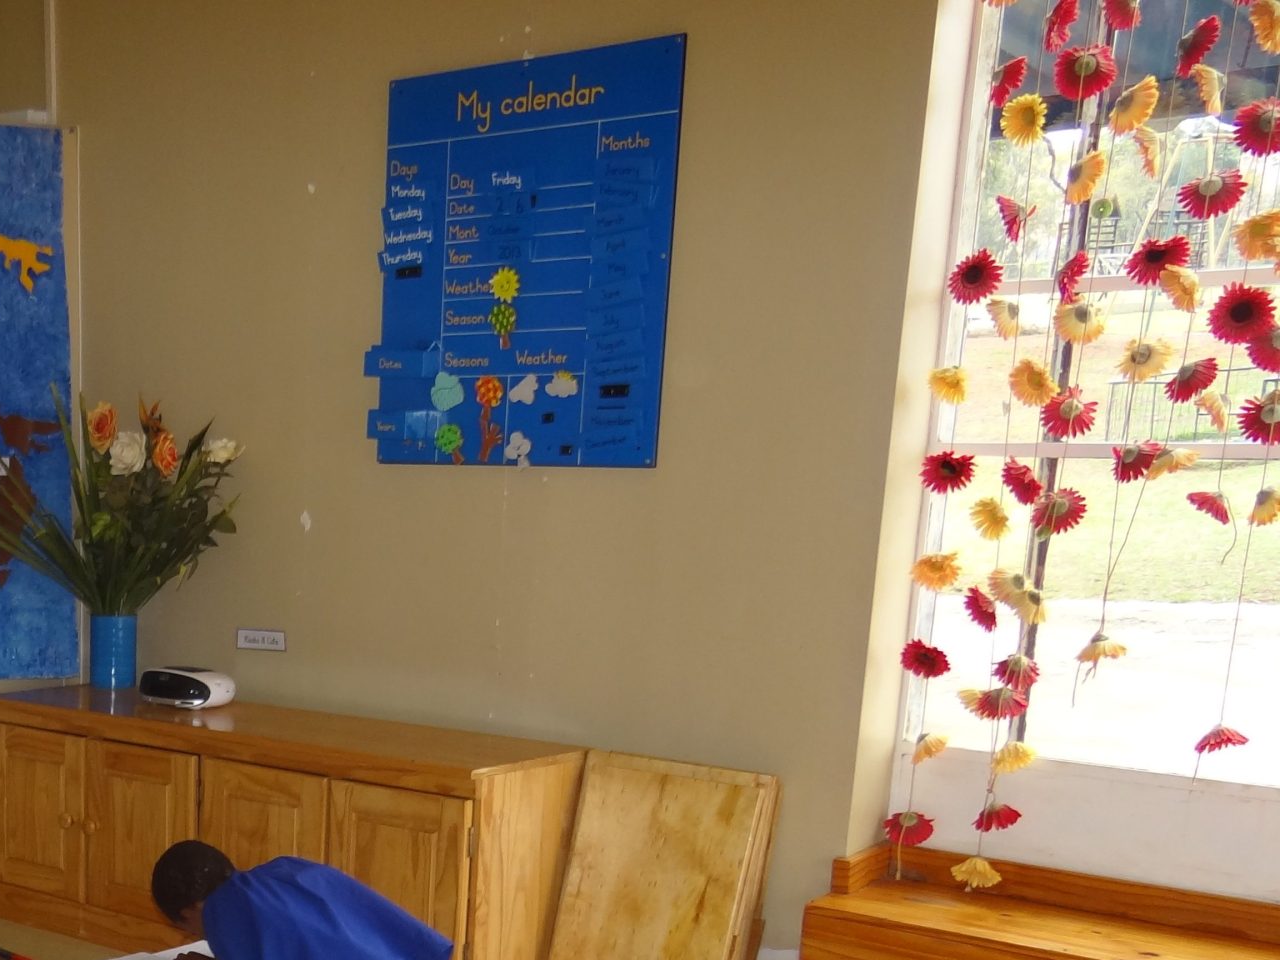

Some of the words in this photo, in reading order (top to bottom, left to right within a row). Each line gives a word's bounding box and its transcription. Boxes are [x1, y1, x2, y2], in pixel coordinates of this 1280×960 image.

[456, 89, 491, 132] My
[500, 73, 604, 115] calendar
[600, 130, 651, 152] Months
[390, 160, 419, 181] Days
[490, 170, 522, 189] Friday
[391, 184, 425, 201] Monday
[449, 174, 474, 195] Day
[389, 205, 422, 222] Tuesday
[449, 202, 475, 215] Date
[384, 225, 433, 245] Wednesday
[448, 224, 480, 240] Mont
[382, 249, 423, 265] Thursday
[448, 247, 472, 264] Year
[445, 276, 492, 294] Weathe
[445, 309, 485, 326] Season
[444, 351, 490, 368] Seasons
[515, 348, 568, 366] Weather
